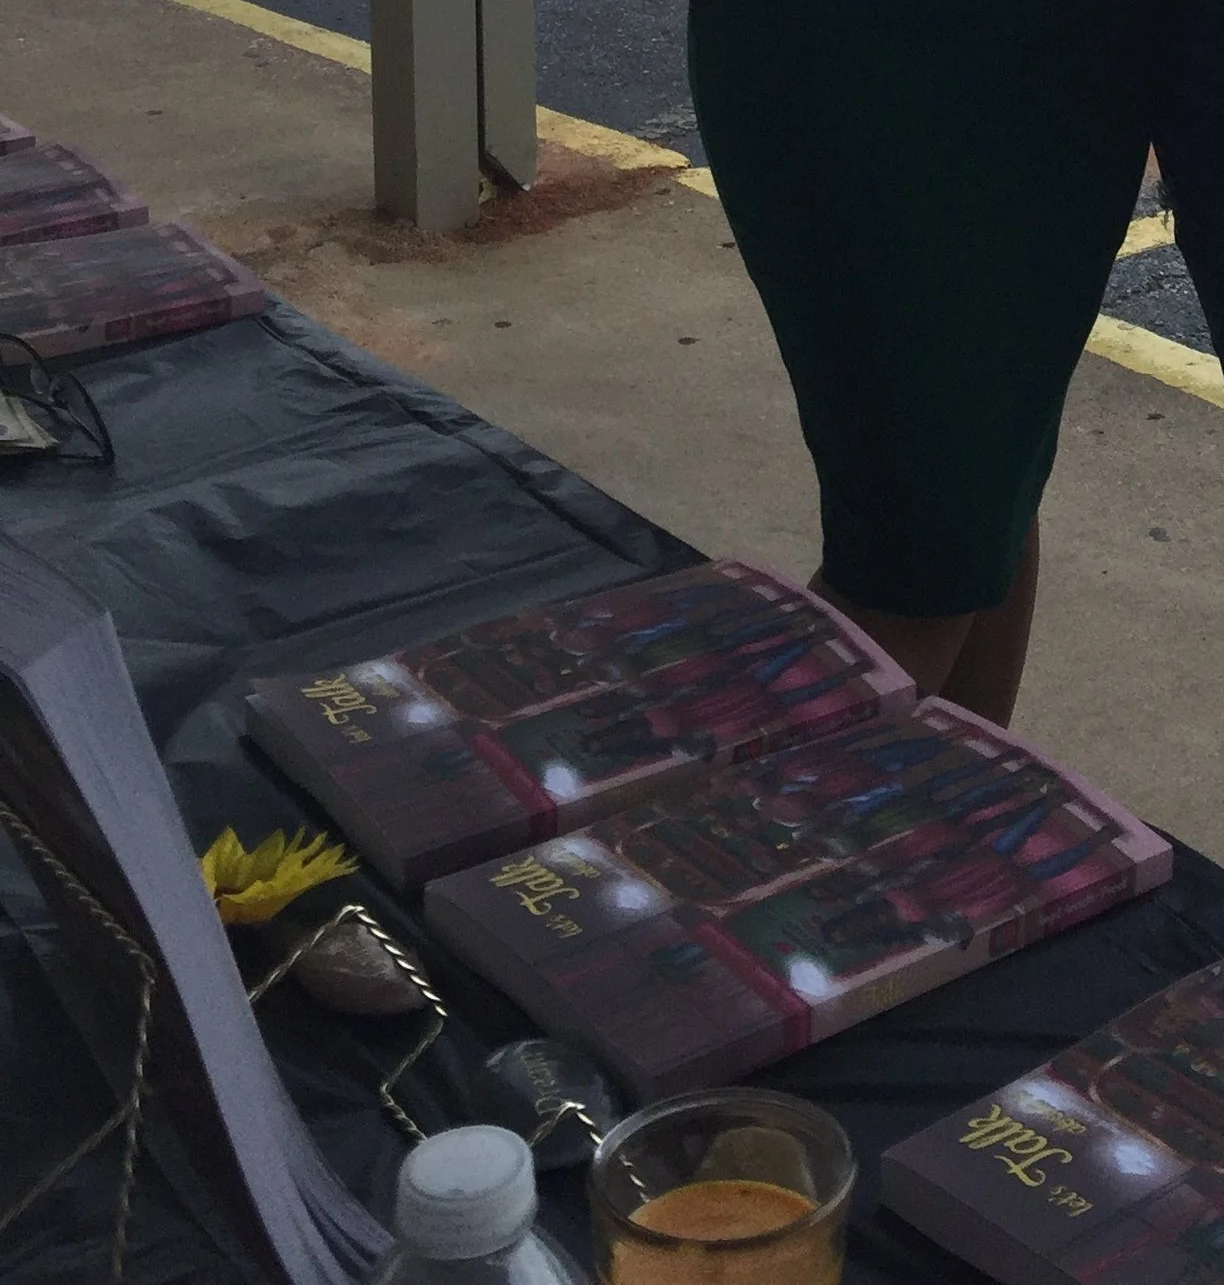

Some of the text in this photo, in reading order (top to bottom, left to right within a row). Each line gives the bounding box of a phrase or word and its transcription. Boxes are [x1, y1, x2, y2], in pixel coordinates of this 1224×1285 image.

[301, 675, 377, 724] Talk
[490, 855, 580, 915] Talk
[959, 1105, 1073, 1187] Talk
